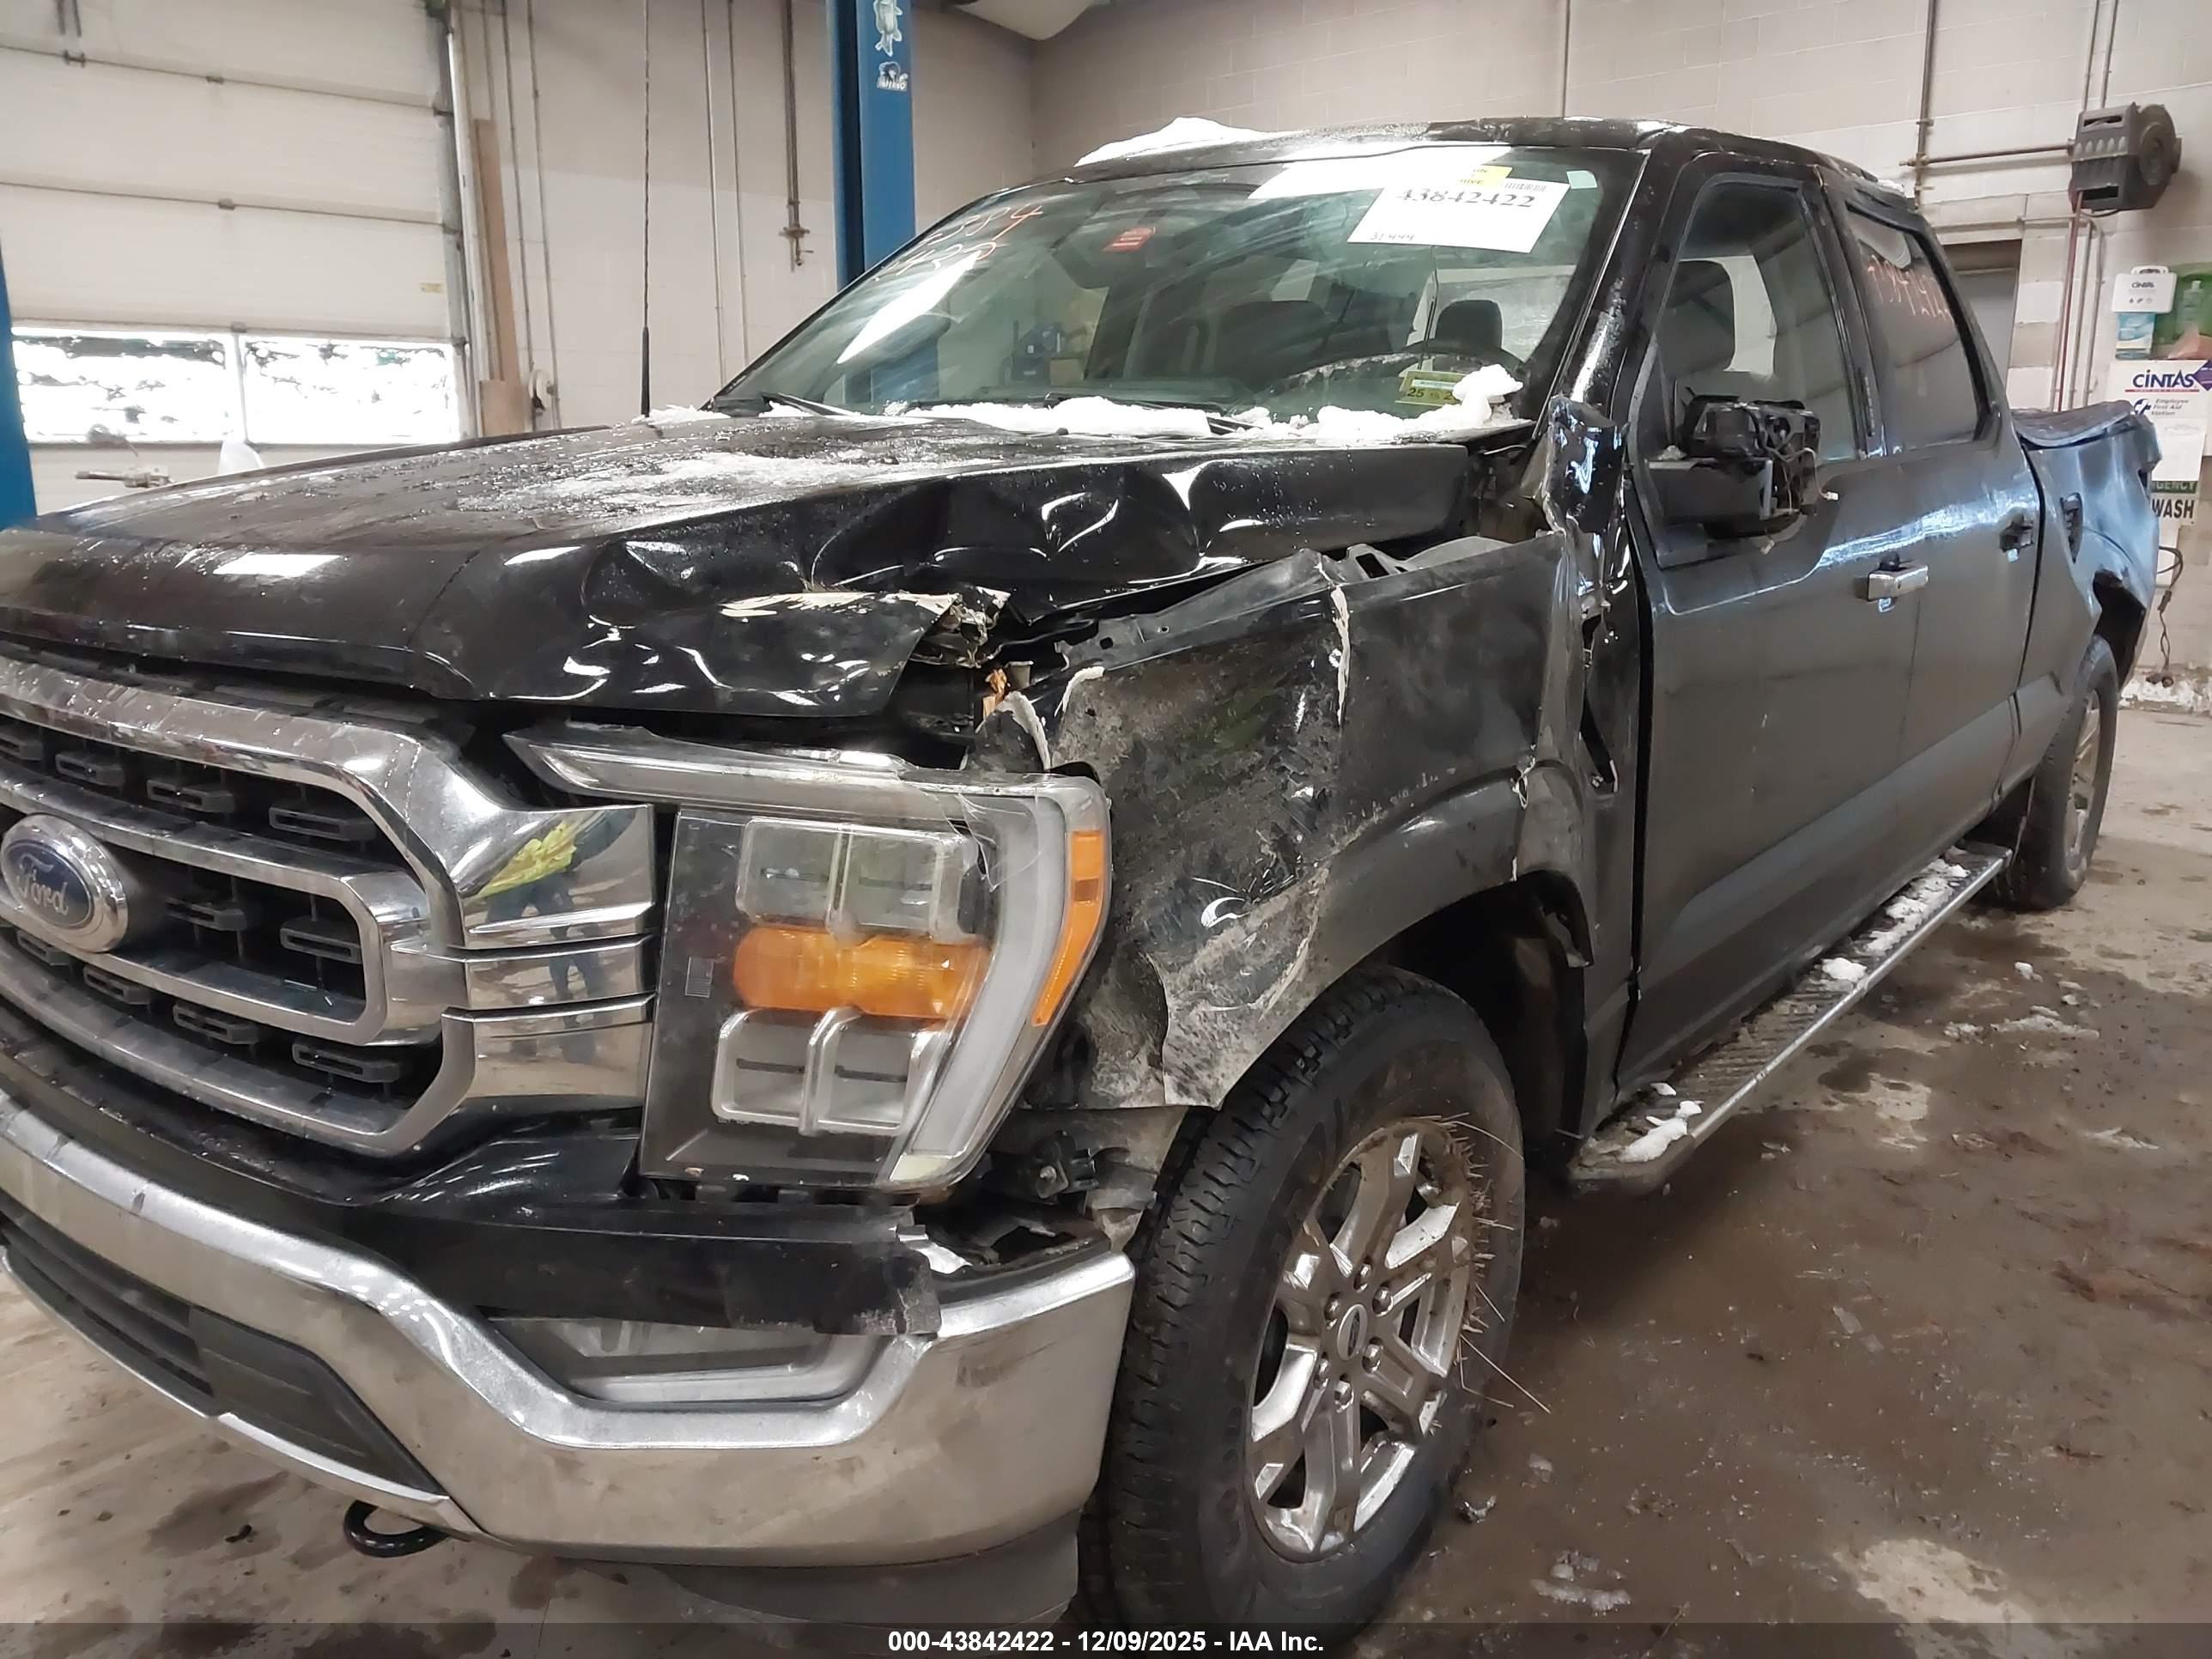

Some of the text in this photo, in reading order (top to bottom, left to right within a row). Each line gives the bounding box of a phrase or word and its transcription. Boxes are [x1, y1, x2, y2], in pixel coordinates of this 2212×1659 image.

[1395, 186, 1535, 209] 43842422
[2152, 498, 2195, 520] WASH
[15, 852, 70, 916] Ford
